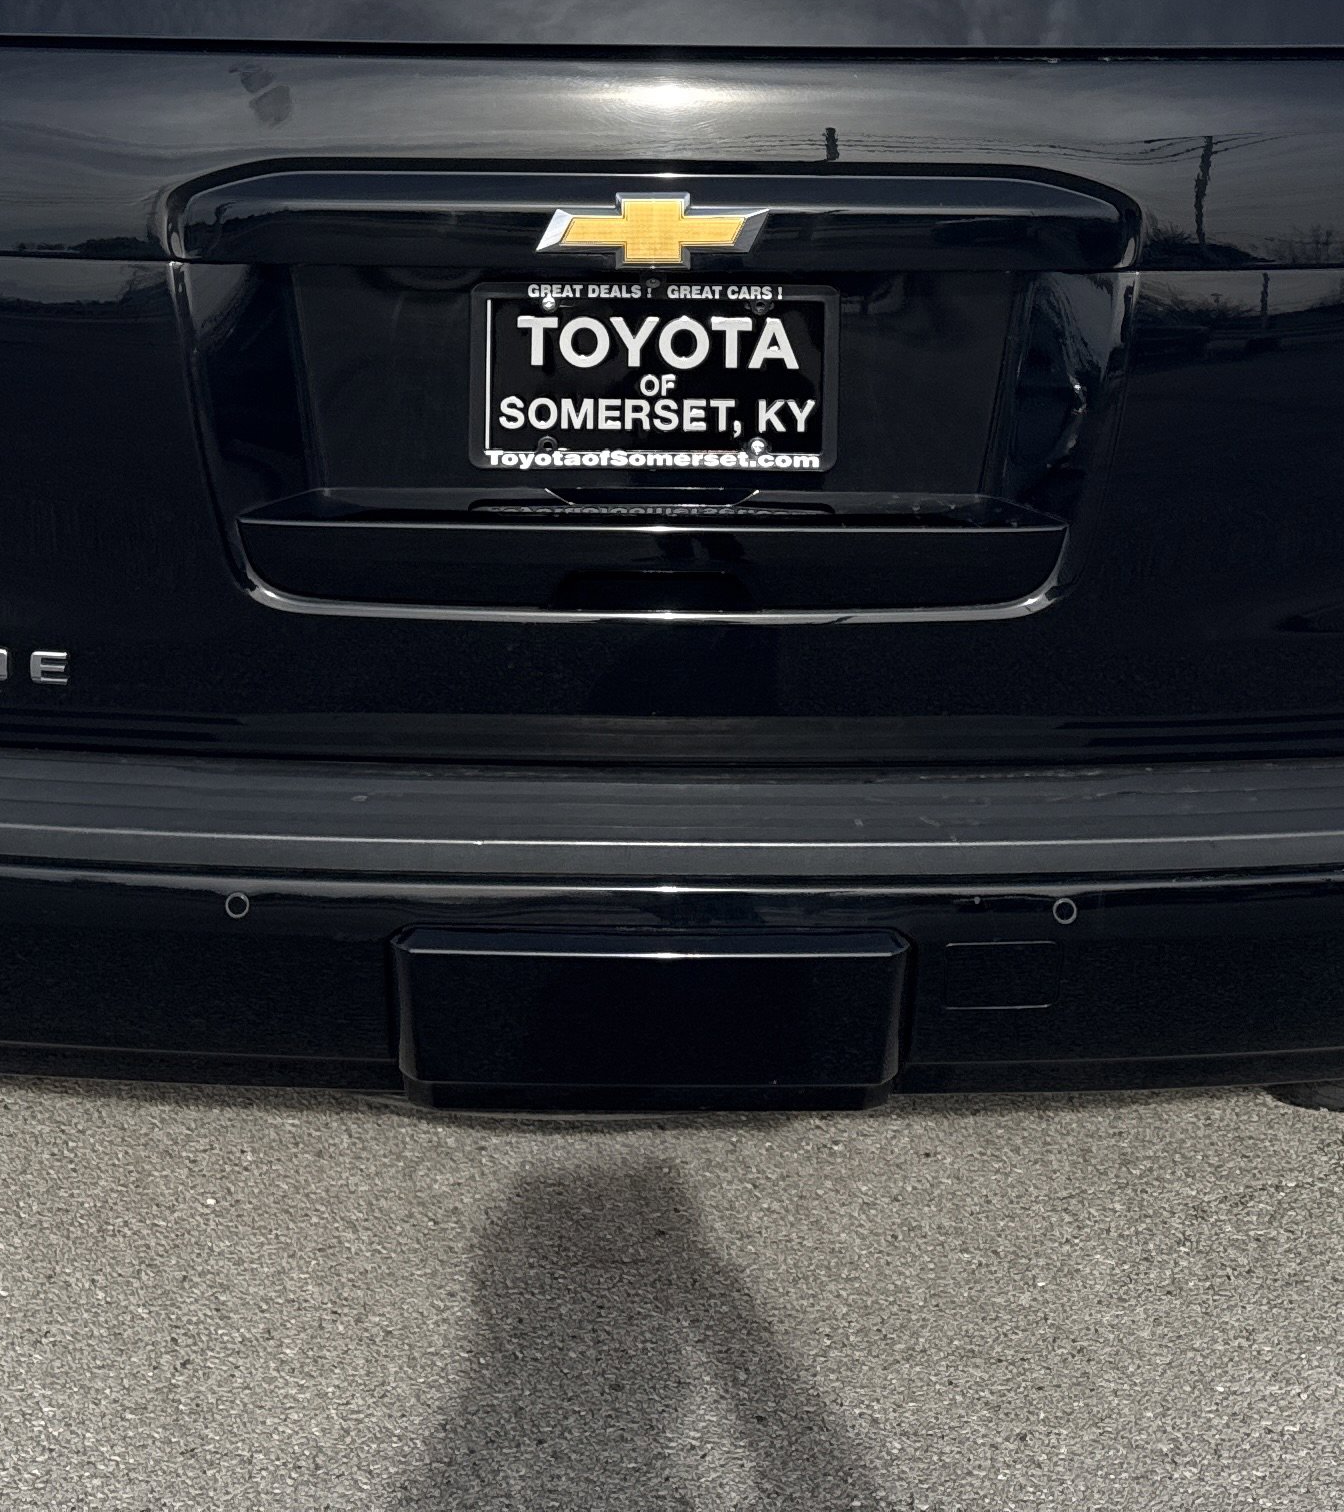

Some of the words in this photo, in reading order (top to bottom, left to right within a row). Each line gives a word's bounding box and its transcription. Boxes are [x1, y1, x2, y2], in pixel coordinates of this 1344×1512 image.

[527, 284, 583, 299] GREAT
[587, 285, 642, 298] DEALS
[667, 285, 722, 299] GREAT
[727, 286, 773, 300] CARS
[517, 315, 799, 369] TOYOTA
[640, 374, 676, 396] OF
[499, 396, 741, 438] SOMERSET,
[757, 399, 816, 433] KY
[486, 450, 820, 469] ToyotaofSomerset.com
